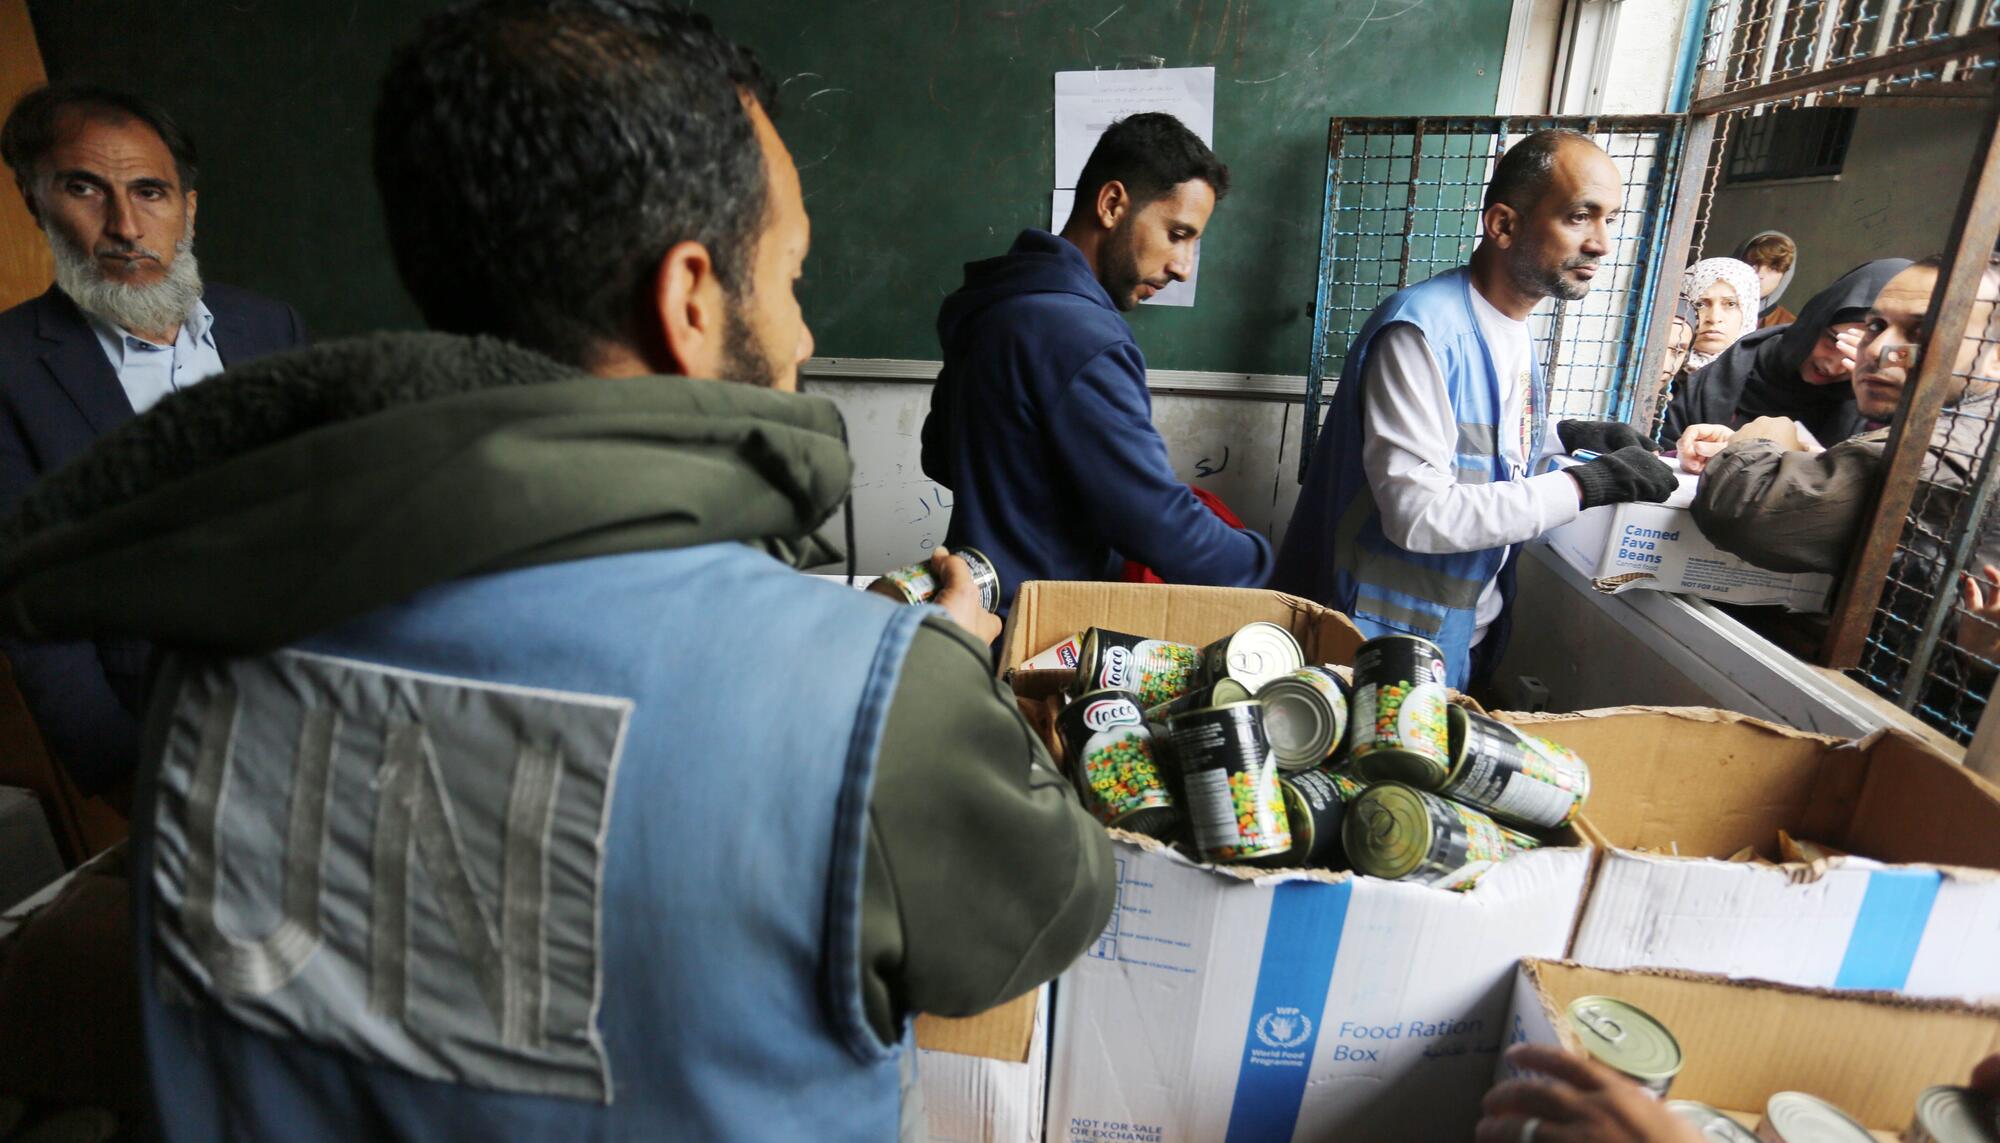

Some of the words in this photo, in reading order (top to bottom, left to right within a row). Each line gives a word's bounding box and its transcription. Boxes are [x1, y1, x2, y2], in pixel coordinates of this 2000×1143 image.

[1625, 524, 1680, 541] Canned
[1622, 536, 1656, 550] Fava
[1618, 548, 1663, 564] Beans
[1681, 581, 1696, 589] NOT
[1697, 582, 1711, 590] FOR
[1712, 584, 1729, 593] SALE
[1276, 1007, 1300, 1015] WFP
[1339, 1021, 1402, 1040] Food
[1407, 1019, 1484, 1038] Ration
[1251, 1049, 1281, 1058] World
[1281, 1051, 1305, 1060] Food
[1333, 1044, 1378, 1061] Box
[1250, 1056, 1304, 1067] Programme
[1071, 1118, 1098, 1128] NOT
[1103, 1121, 1128, 1131] FOR
[1133, 1124, 1163, 1134] SALE
[1070, 1127, 1089, 1137] OR
[1092, 1129, 1163, 1142] EXCHANGE
